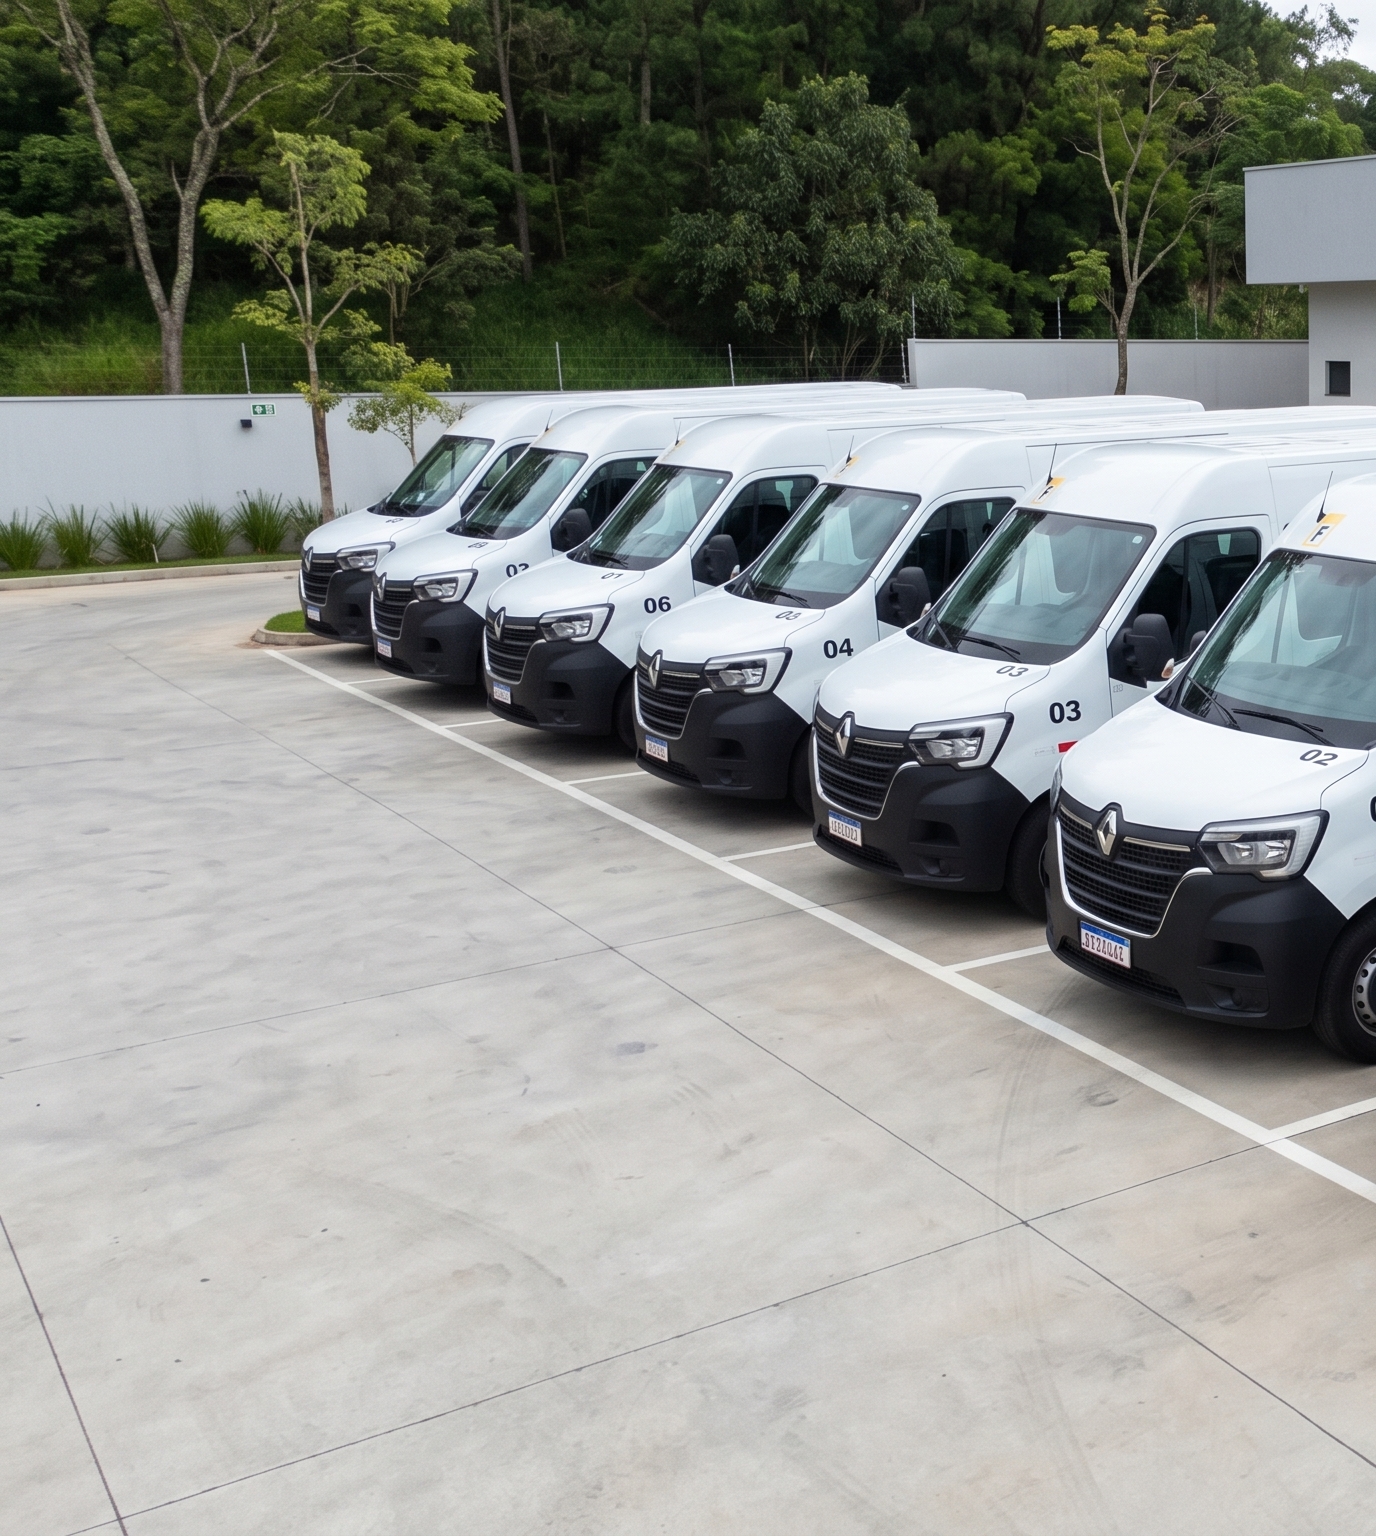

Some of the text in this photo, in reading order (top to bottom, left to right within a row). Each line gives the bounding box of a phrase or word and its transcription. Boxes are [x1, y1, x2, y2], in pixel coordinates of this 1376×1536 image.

[1310, 526, 1330, 541] F
[644, 596, 671, 614] 06
[823, 638, 854, 659] 04
[996, 665, 1029, 677] 03
[1049, 700, 1082, 724] 03
[1299, 749, 1338, 766] 02
